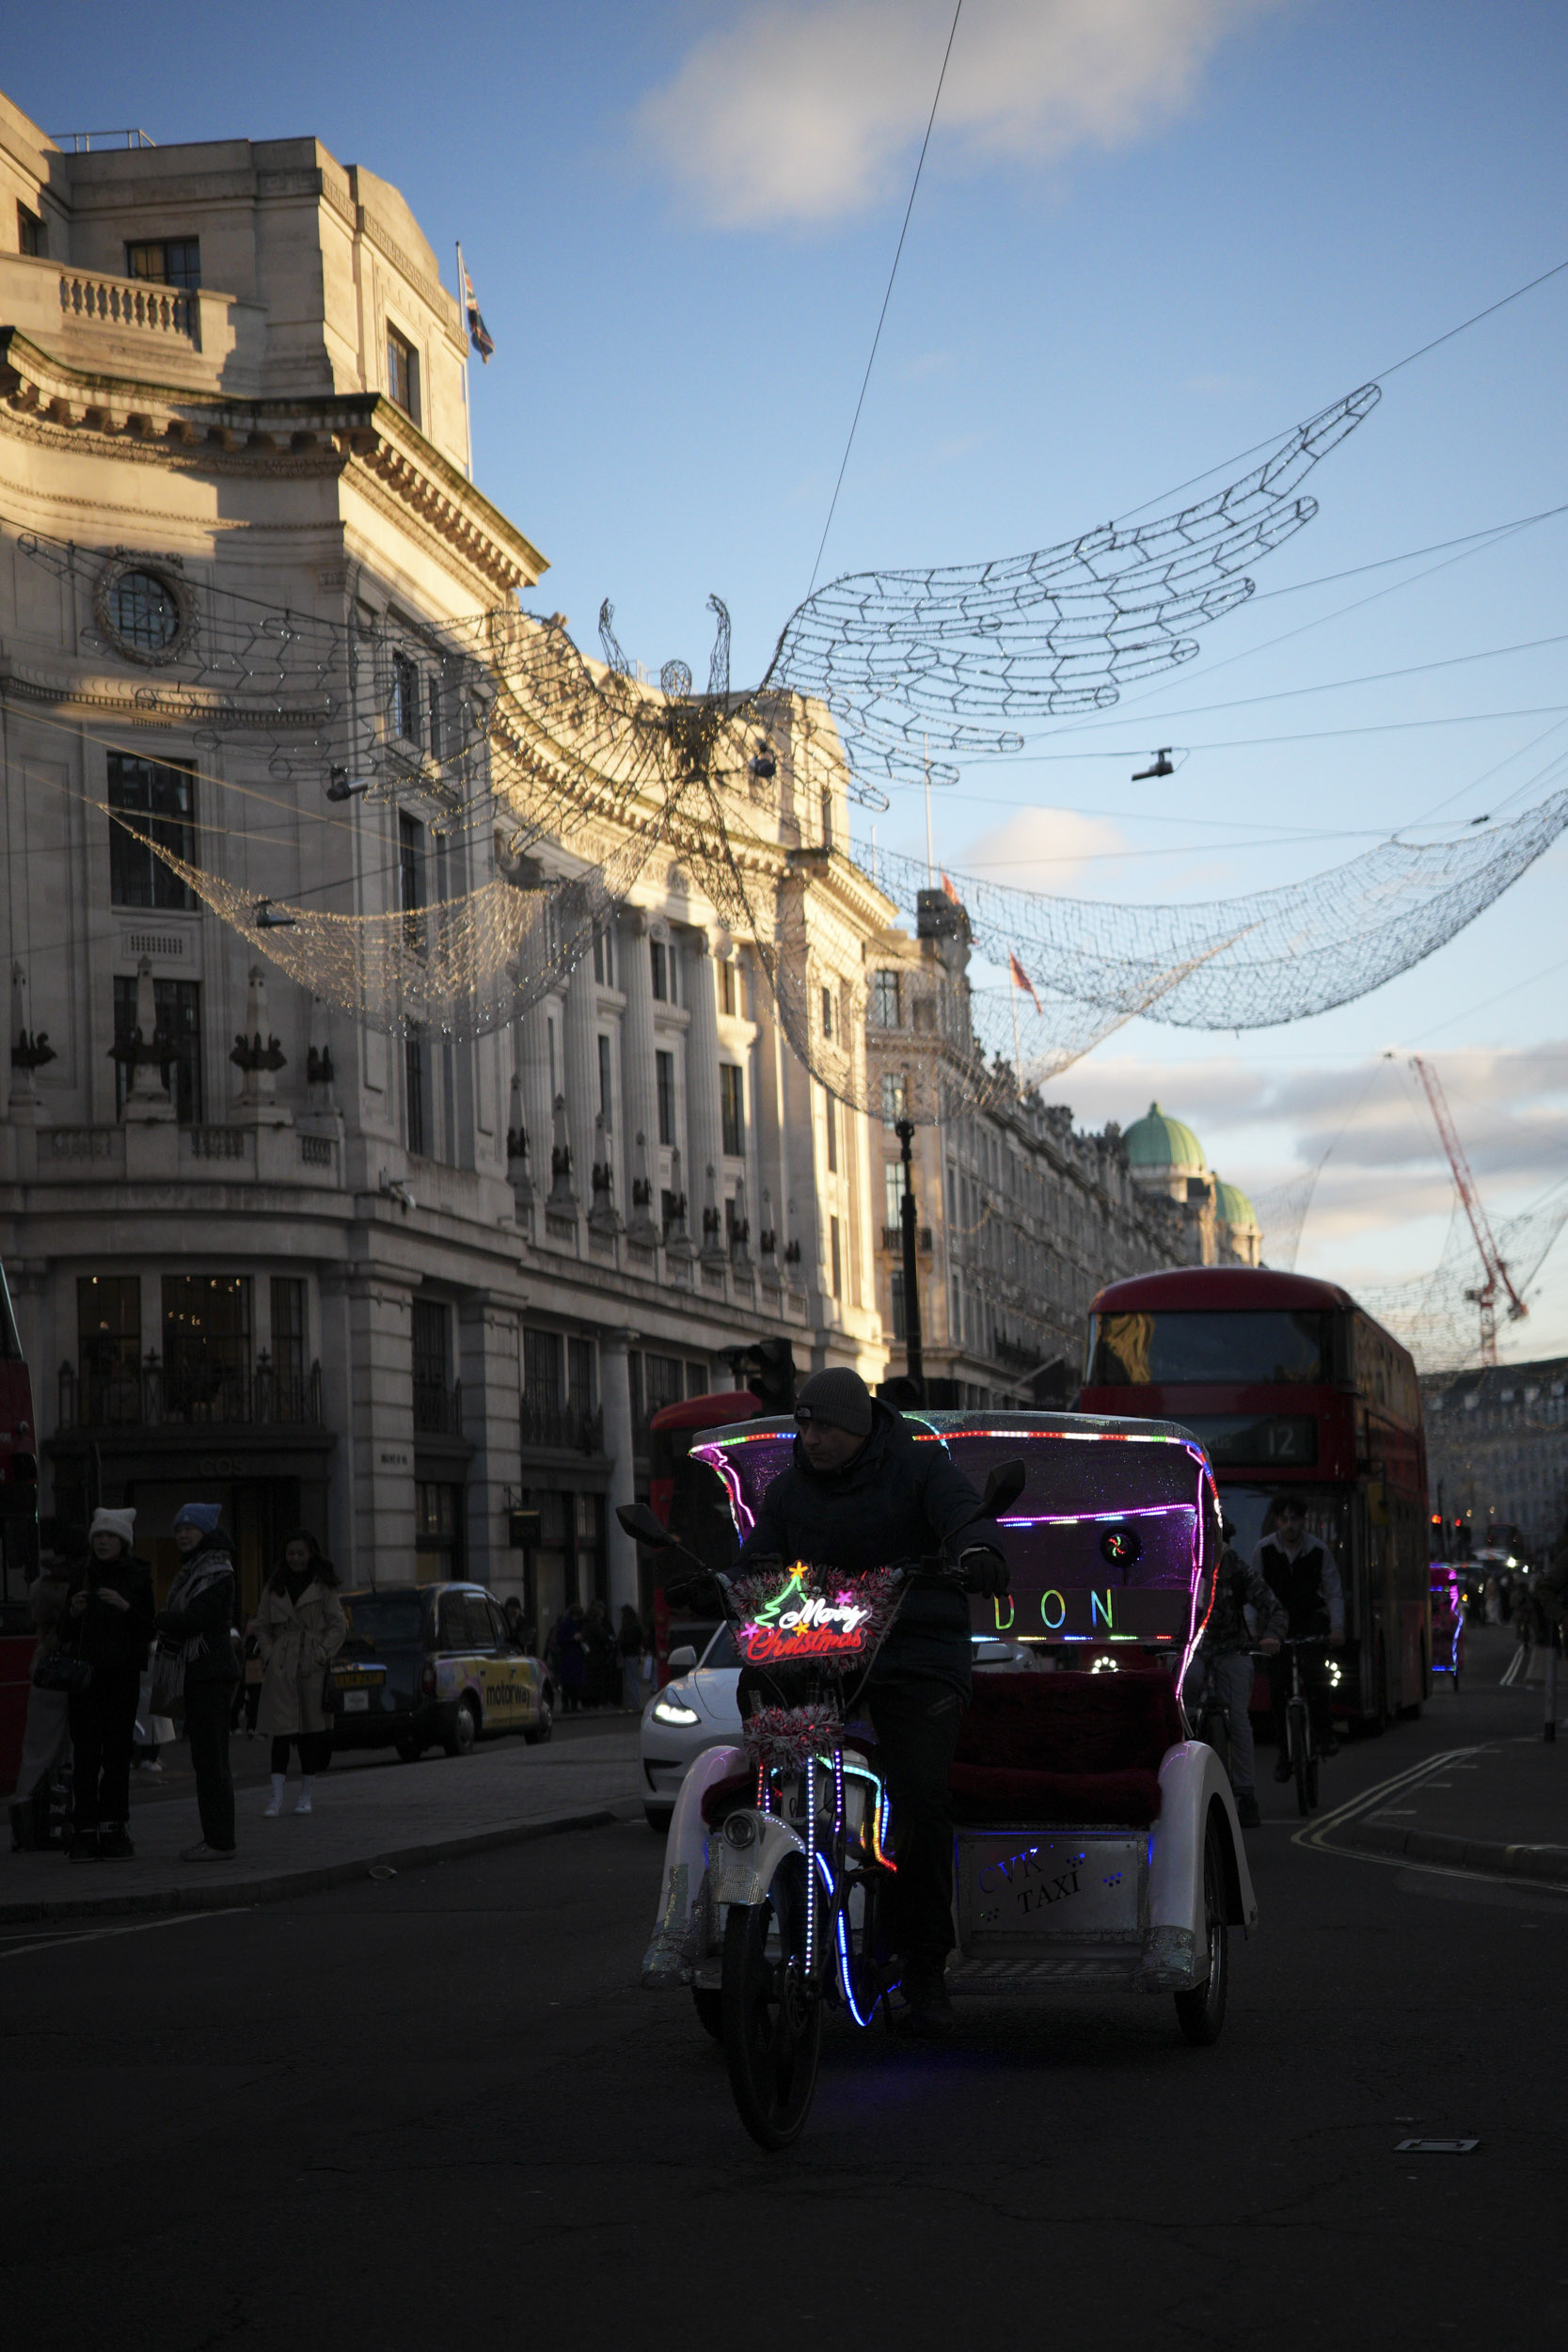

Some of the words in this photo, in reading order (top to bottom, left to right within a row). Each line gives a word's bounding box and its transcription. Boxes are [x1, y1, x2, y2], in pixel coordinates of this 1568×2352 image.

[1268, 1425, 1296, 1456] 12
[198, 1457, 247, 1477] COS
[779, 1597, 868, 1633] Merry
[747, 1624, 863, 1661] Christmas
[486, 1679, 531, 1709] motorway
[1017, 1870, 1082, 1915] TAXI
